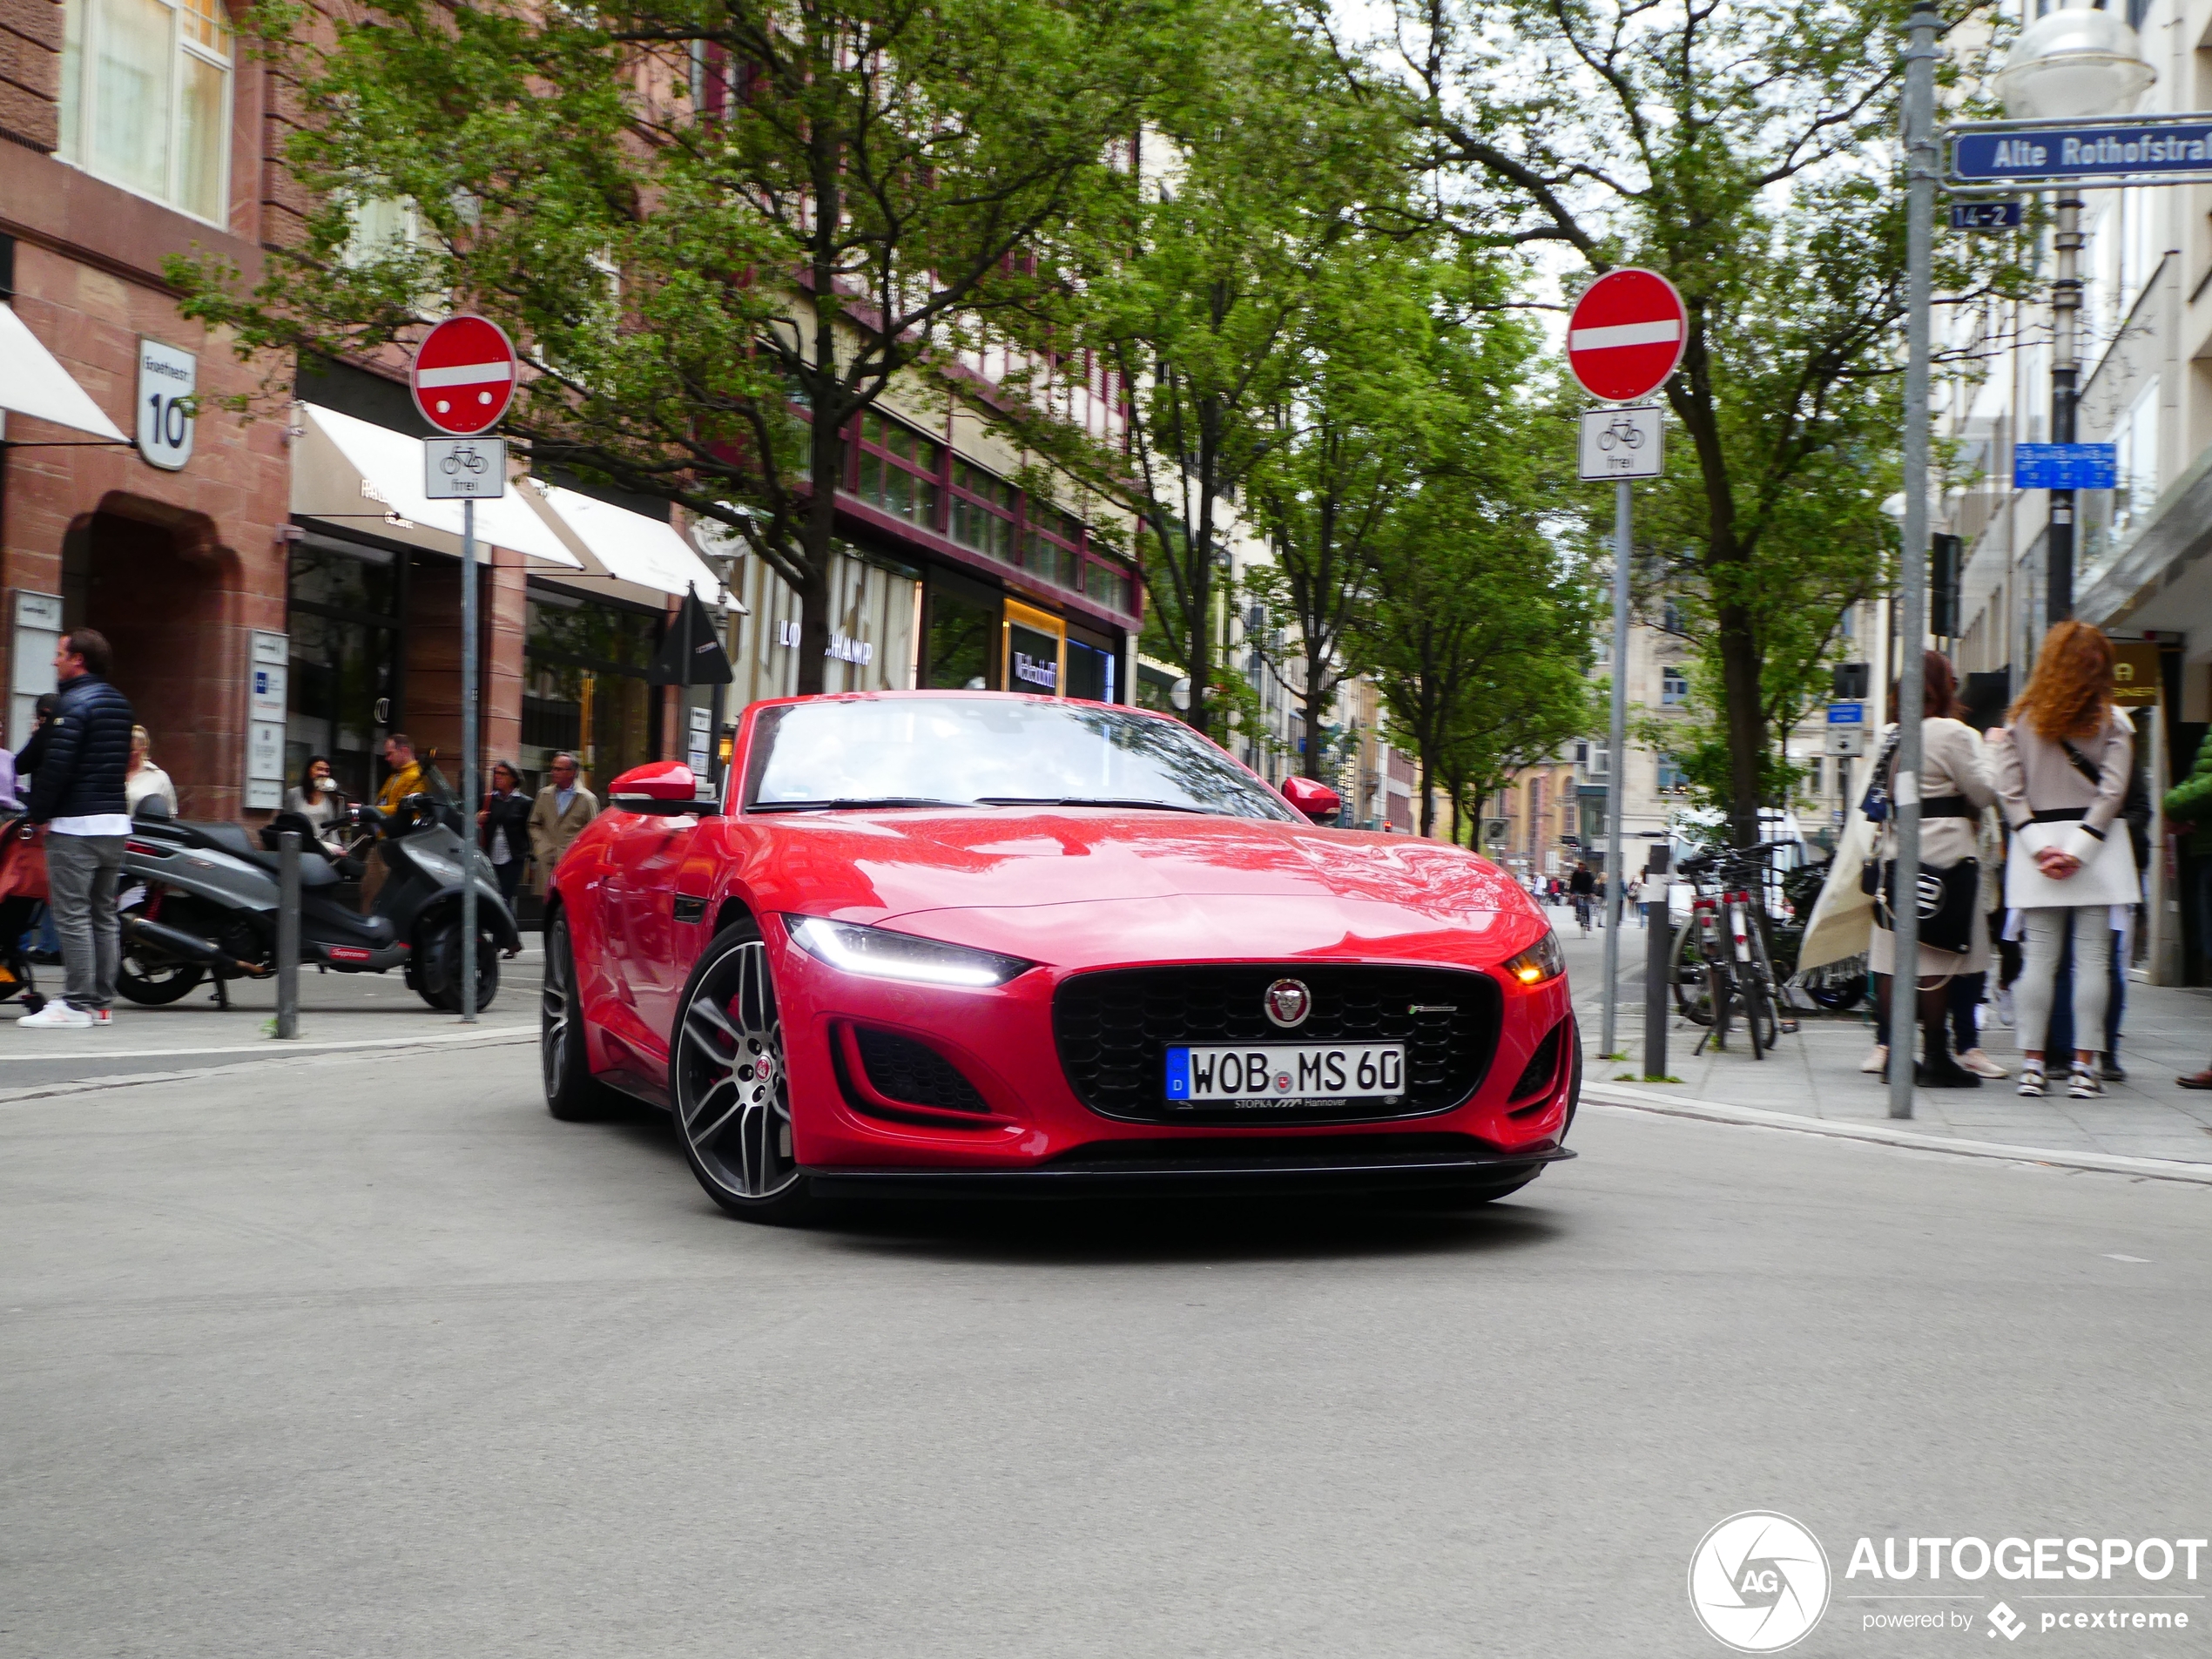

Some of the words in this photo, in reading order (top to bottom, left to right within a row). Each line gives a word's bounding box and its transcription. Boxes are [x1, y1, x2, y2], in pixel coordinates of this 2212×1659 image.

[1992, 139, 2047, 167] Alte
[1953, 206, 2006, 226] 14-2
[149, 393, 185, 448] 10
[1606, 455, 1635, 469] frei
[451, 478, 479, 491] frei
[1191, 1052, 1270, 1094] WOB
[1298, 1050, 1346, 1091] MS
[1357, 1049, 1401, 1089] 60
[1173, 1079, 1183, 1091] D
[1235, 1099, 1272, 1109] STOPKA
[1305, 1098, 1346, 1107] Hannover
